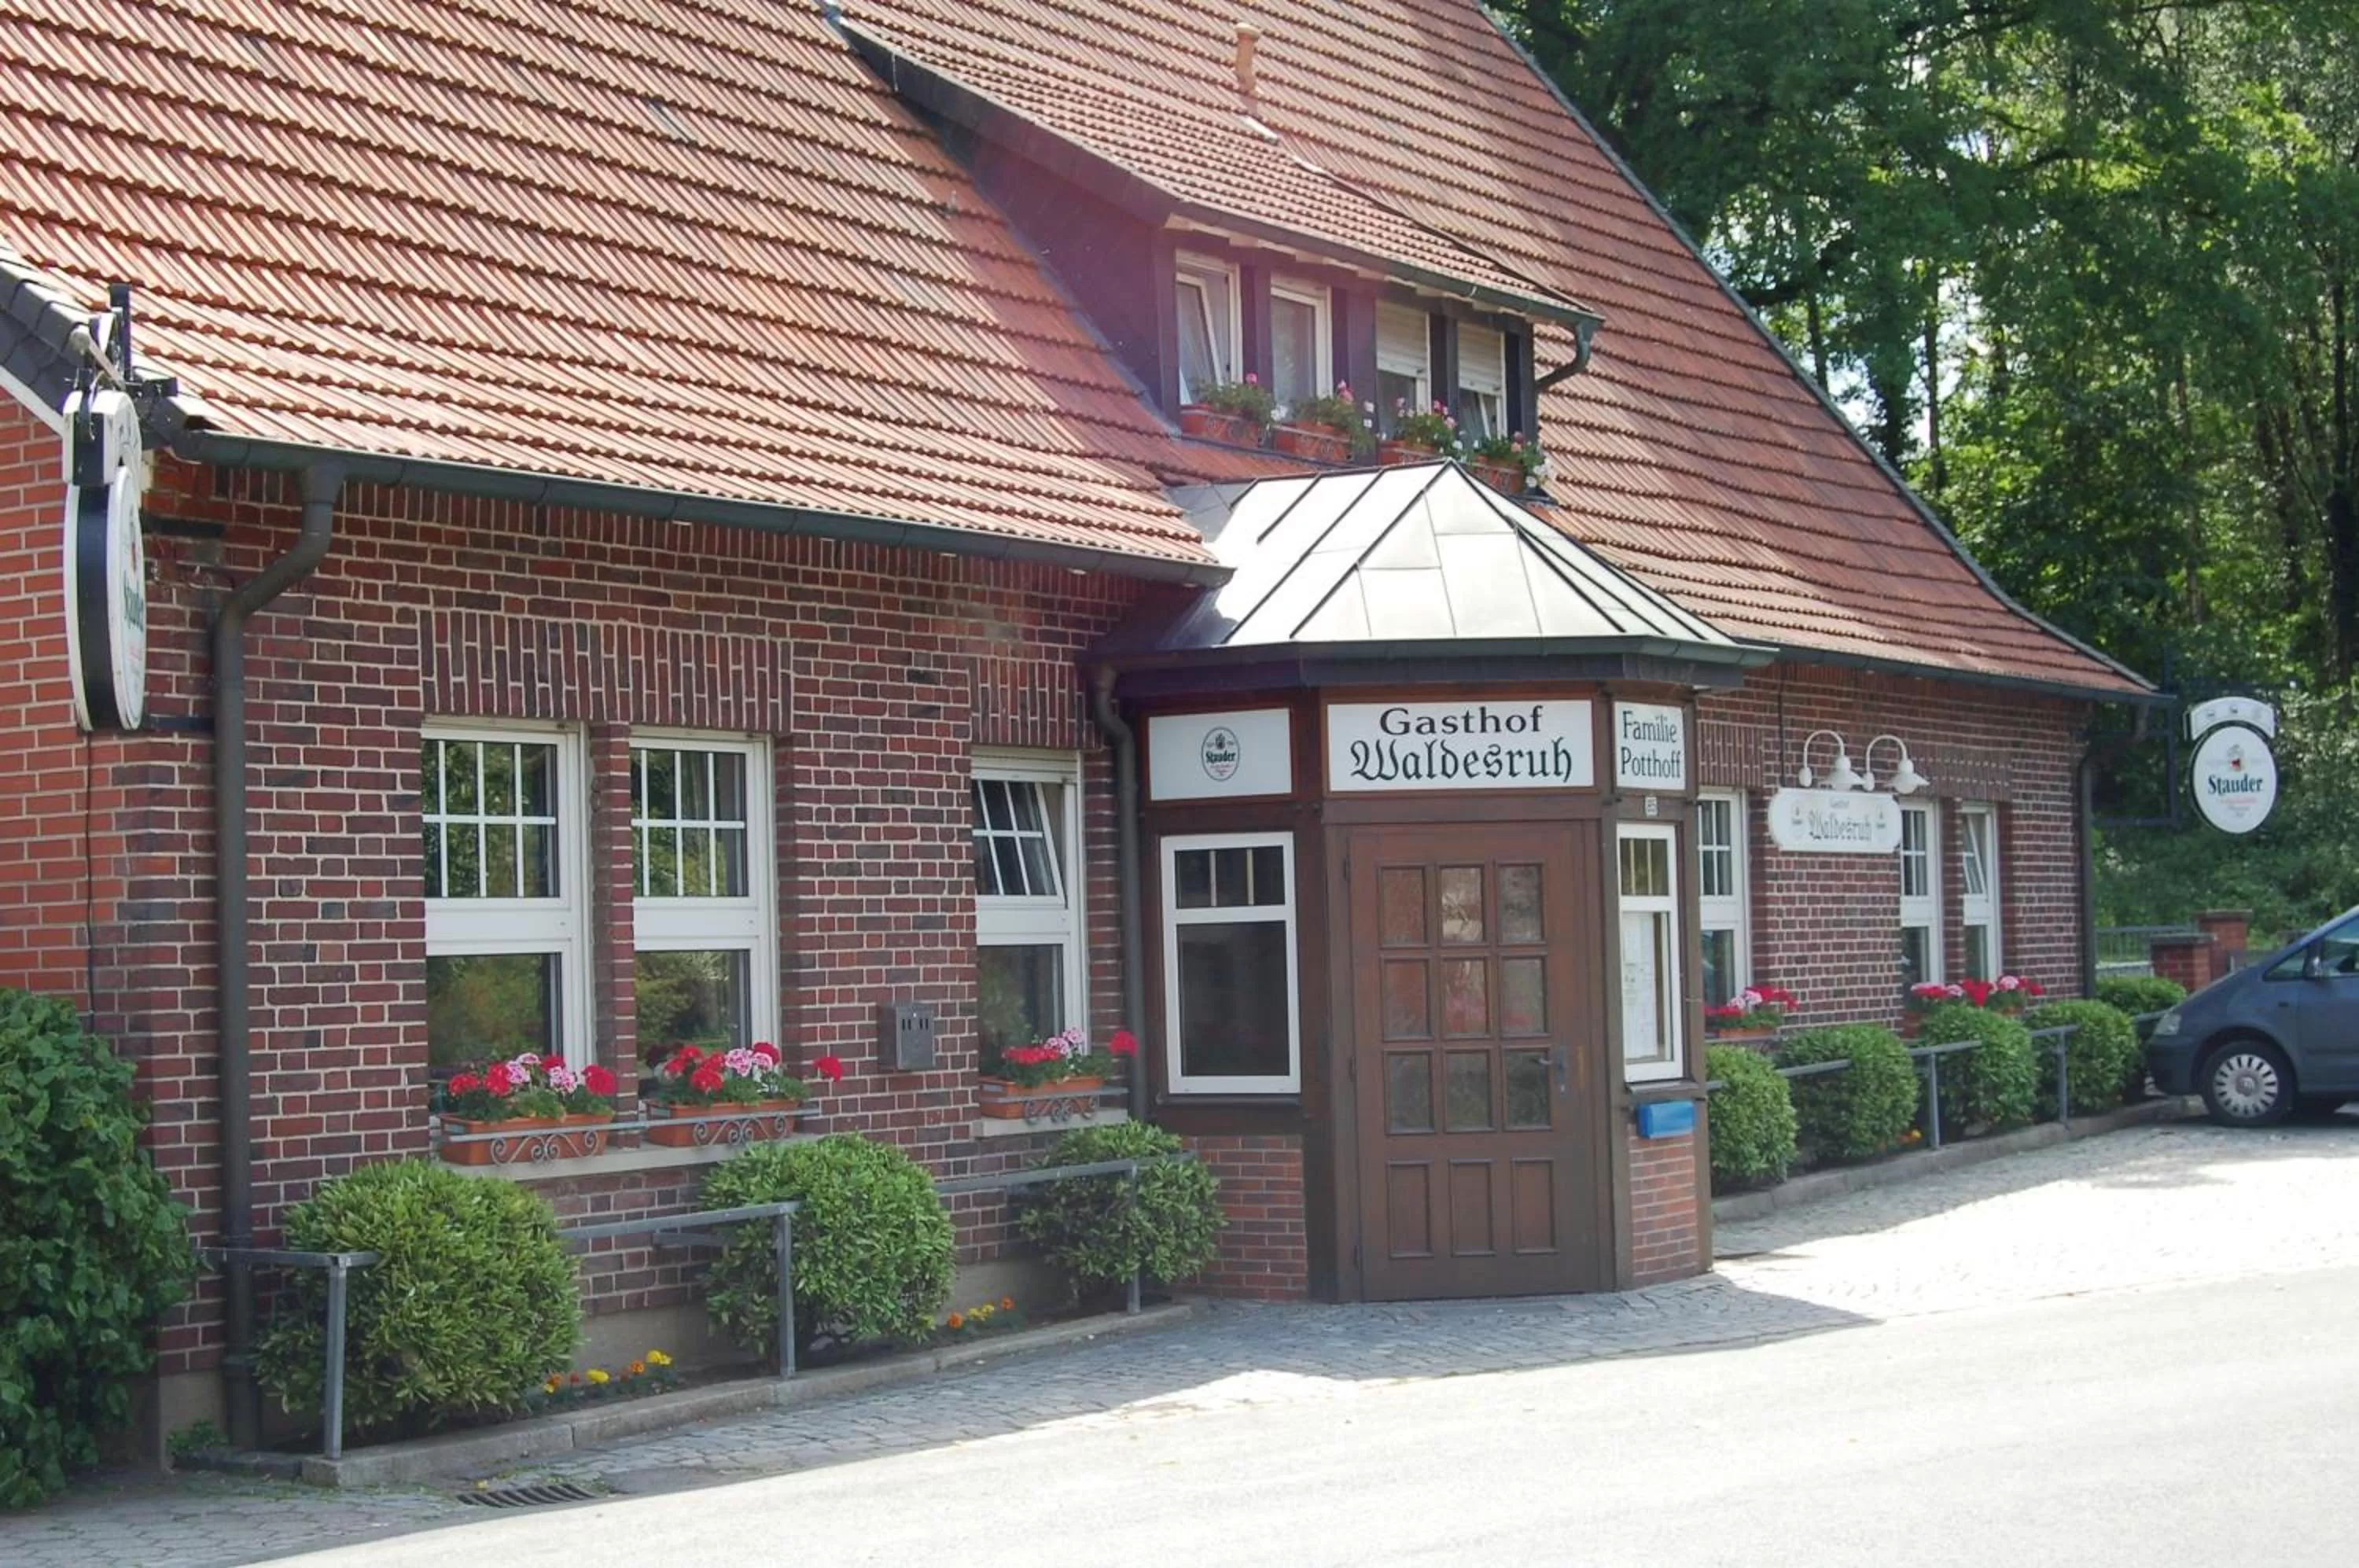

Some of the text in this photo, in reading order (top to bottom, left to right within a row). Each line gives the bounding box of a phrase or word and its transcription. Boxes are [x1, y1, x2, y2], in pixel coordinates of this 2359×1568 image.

[1380, 705, 1544, 735] Gasthof
[1622, 710, 1676, 743] Familie
[1205, 750, 1236, 764] Stauder
[1350, 737, 1572, 783] Waldesruh
[1621, 746, 1681, 778] Potthoff
[2208, 774, 2263, 796] Stauder
